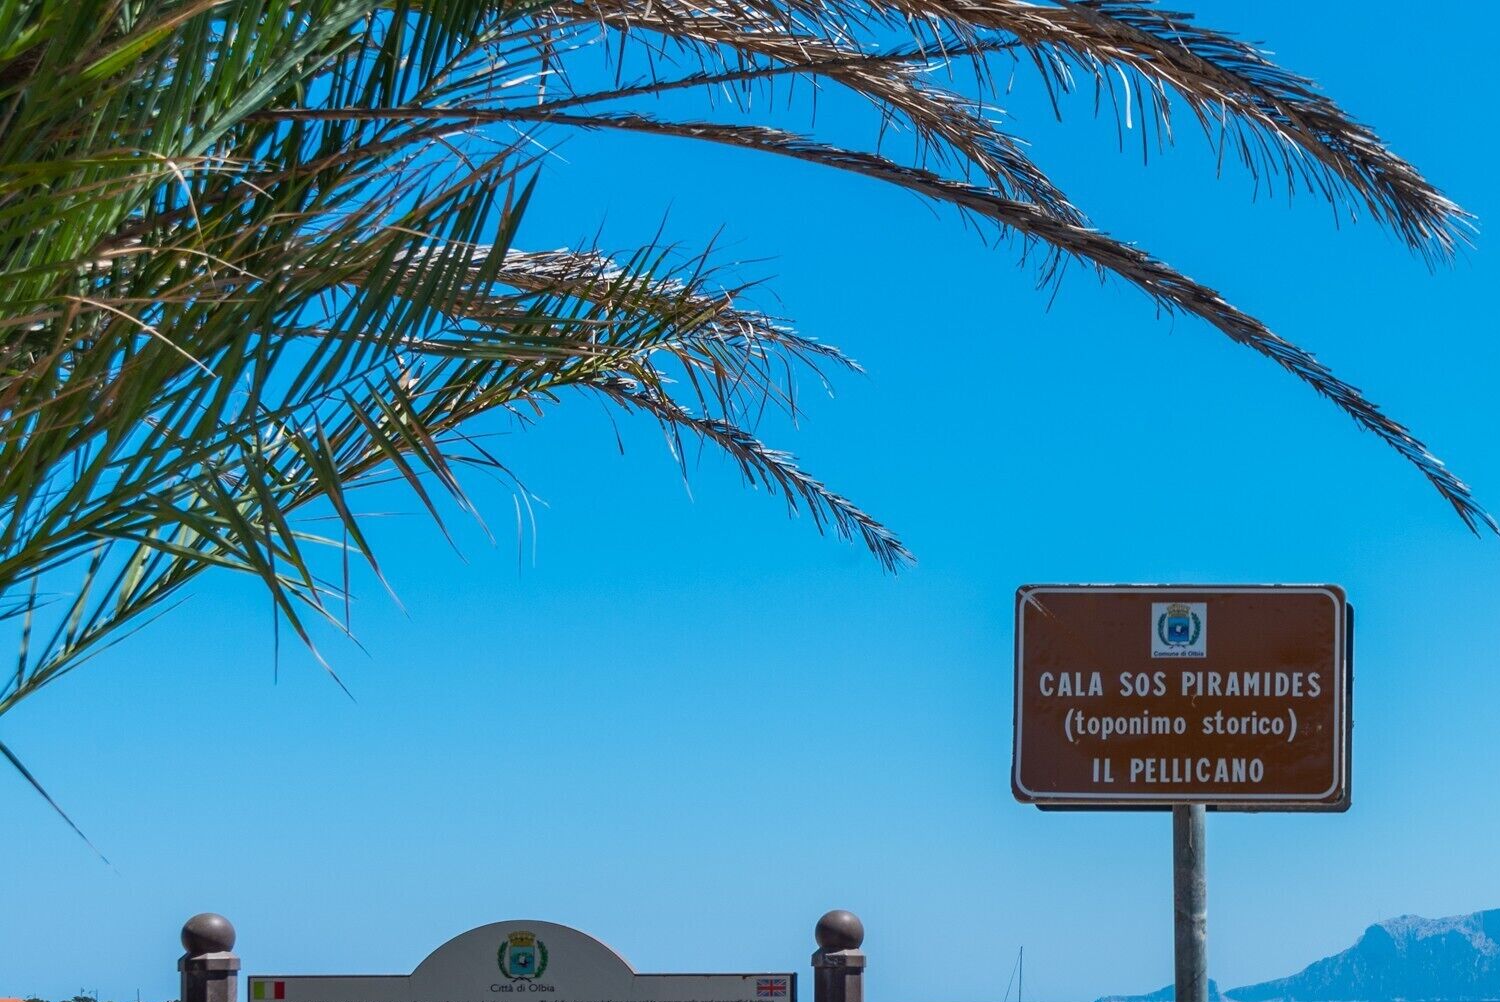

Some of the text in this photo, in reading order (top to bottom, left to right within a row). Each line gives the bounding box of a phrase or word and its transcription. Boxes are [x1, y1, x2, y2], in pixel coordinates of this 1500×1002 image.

[1039, 671, 1321, 697] CALA SOS PIRAMIDES
[1064, 708, 1297, 743] (toponimo storico)
[1093, 758, 1264, 783] IL PELLICANO
[490, 984, 554, 992] Città di Olbia
